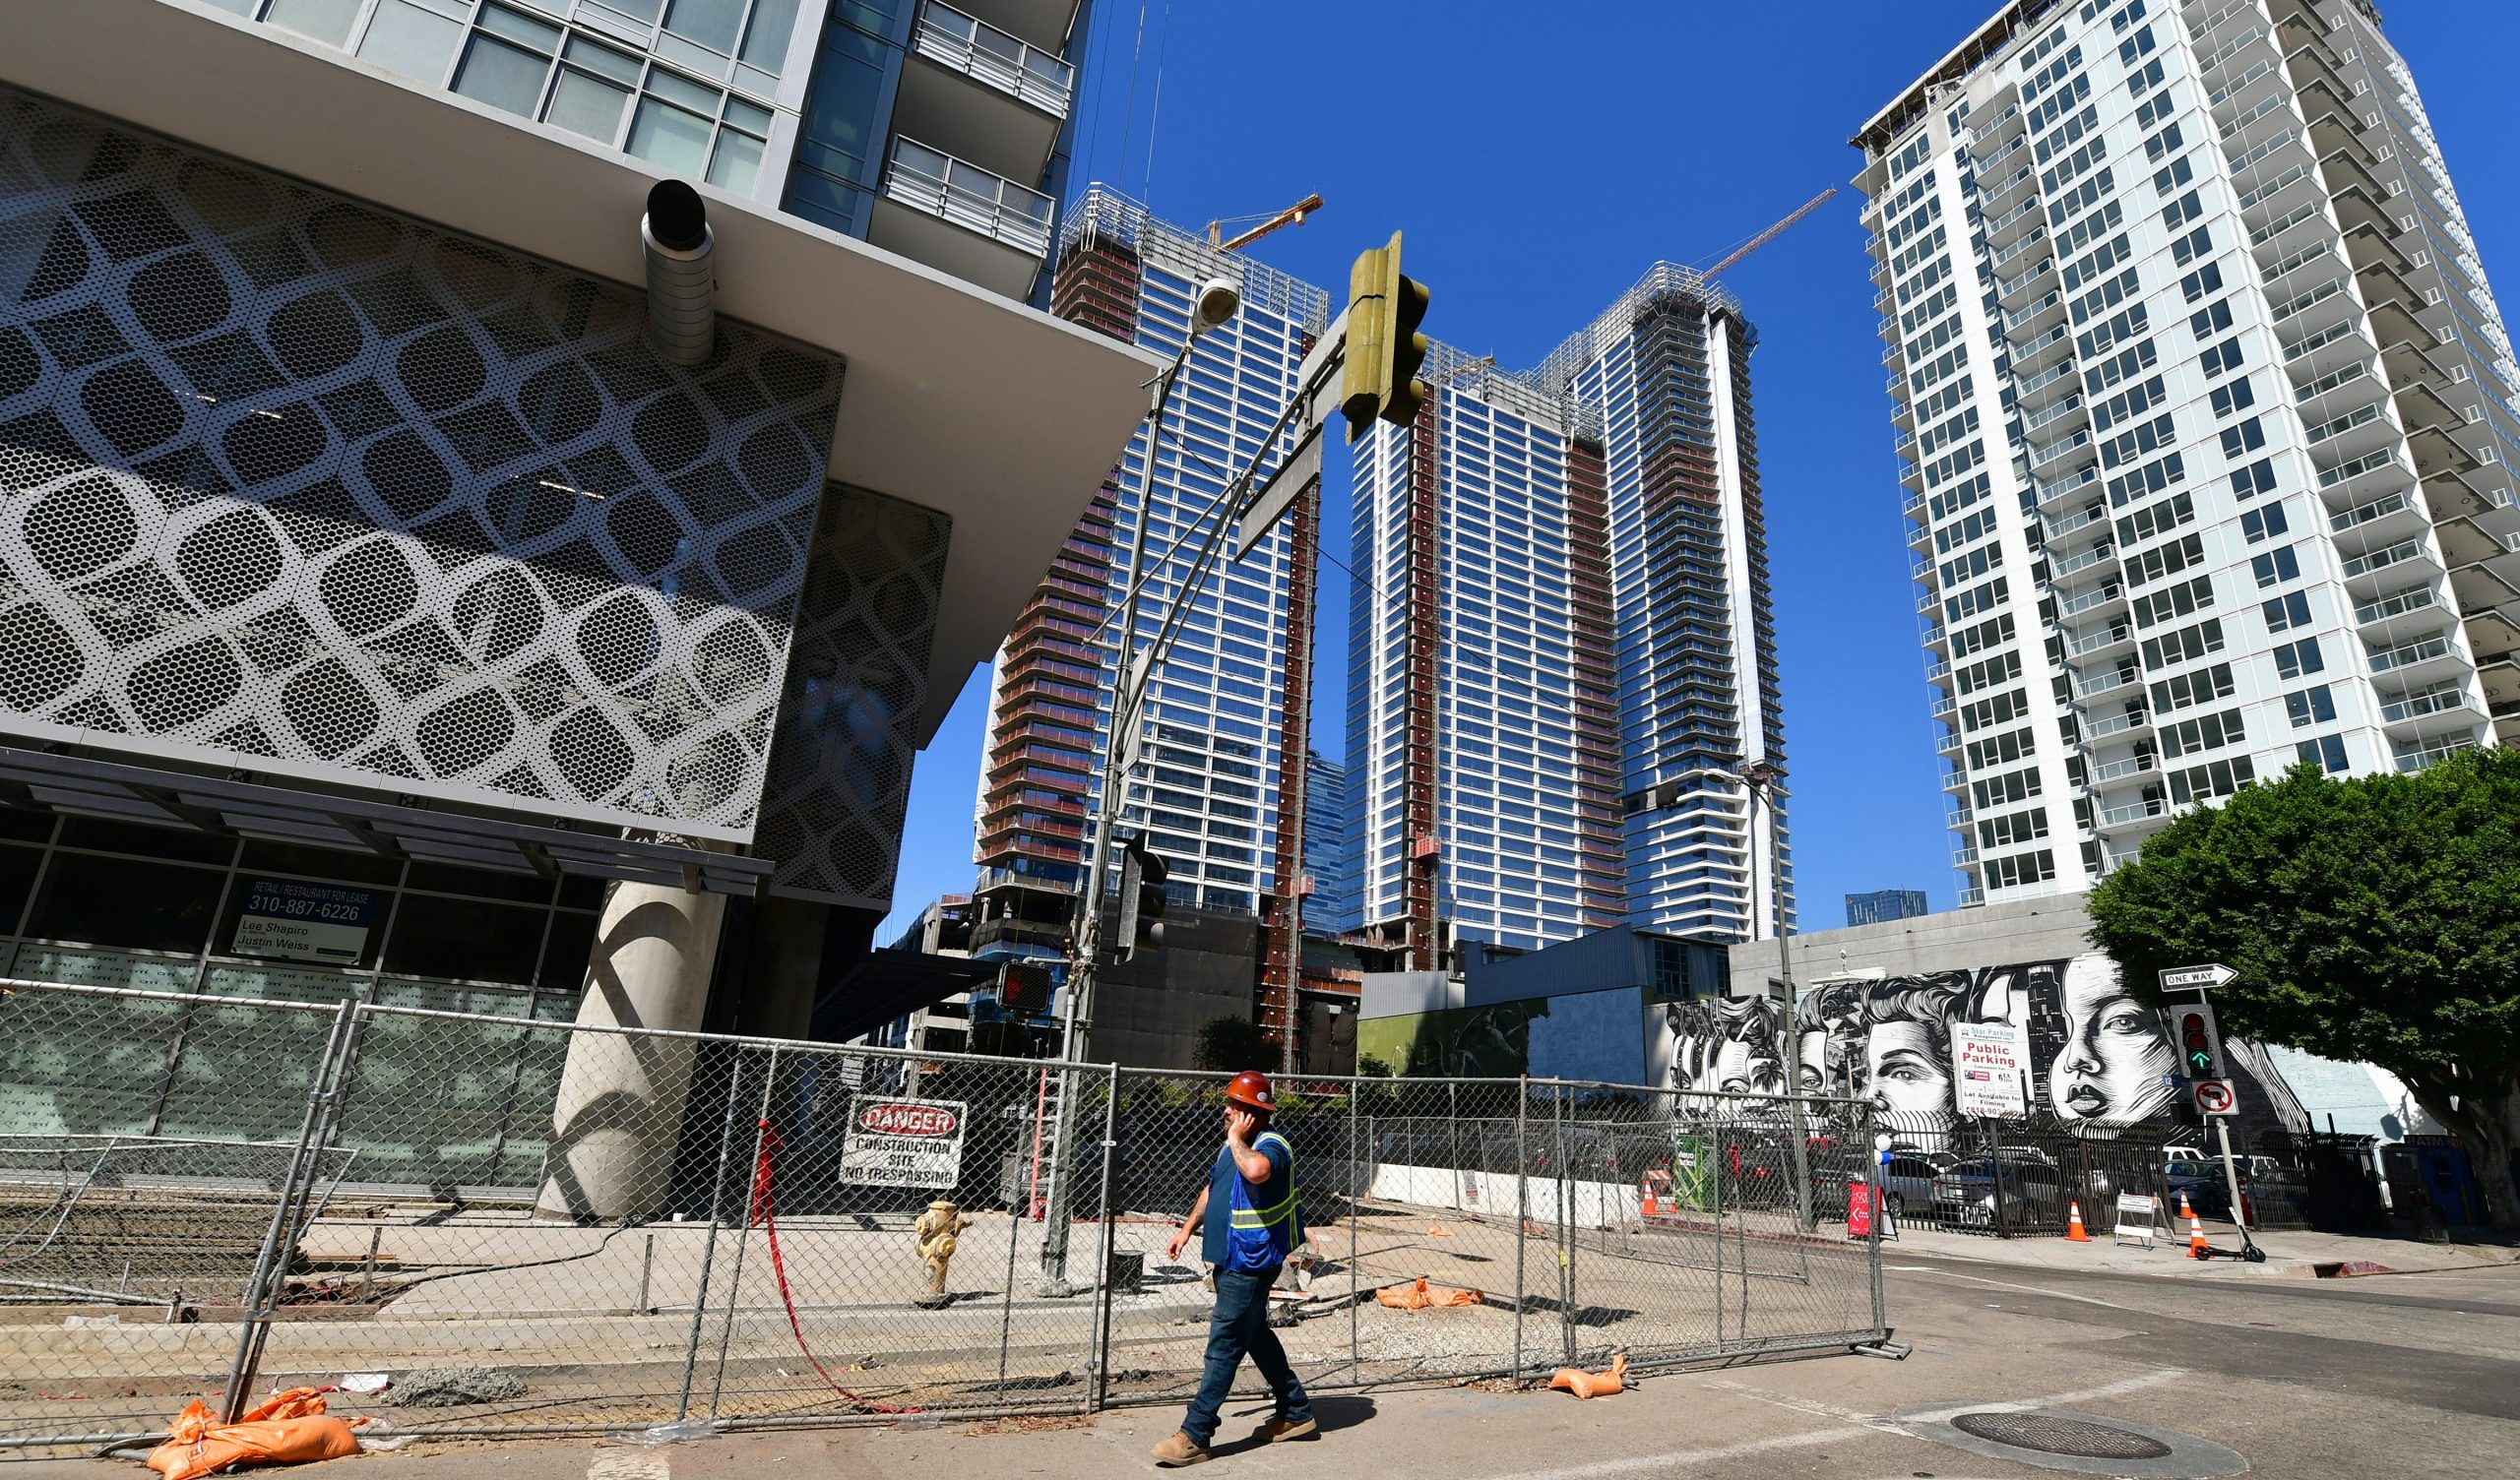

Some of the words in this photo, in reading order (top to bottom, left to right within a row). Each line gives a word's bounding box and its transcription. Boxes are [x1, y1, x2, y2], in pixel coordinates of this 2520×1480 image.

[249, 894, 359, 921] 310-887-6226
[242, 920, 263, 932] Lee
[265, 922, 308, 936] Shapiro
[237, 935, 272, 948] Justin
[276, 938, 310, 951] Weiss
[2168, 975, 2188, 984] ONE
[2191, 971, 2213, 981] WAY
[1967, 1042, 2010, 1055] Public
[1962, 1052, 2015, 1069] Parking
[866, 1108, 950, 1132] DANGER
[855, 1138, 951, 1154] CONSTRUCTION
[888, 1154, 915, 1167] SITE
[846, 1167, 863, 1180] NO
[867, 1167, 953, 1183] TRESPASSING
